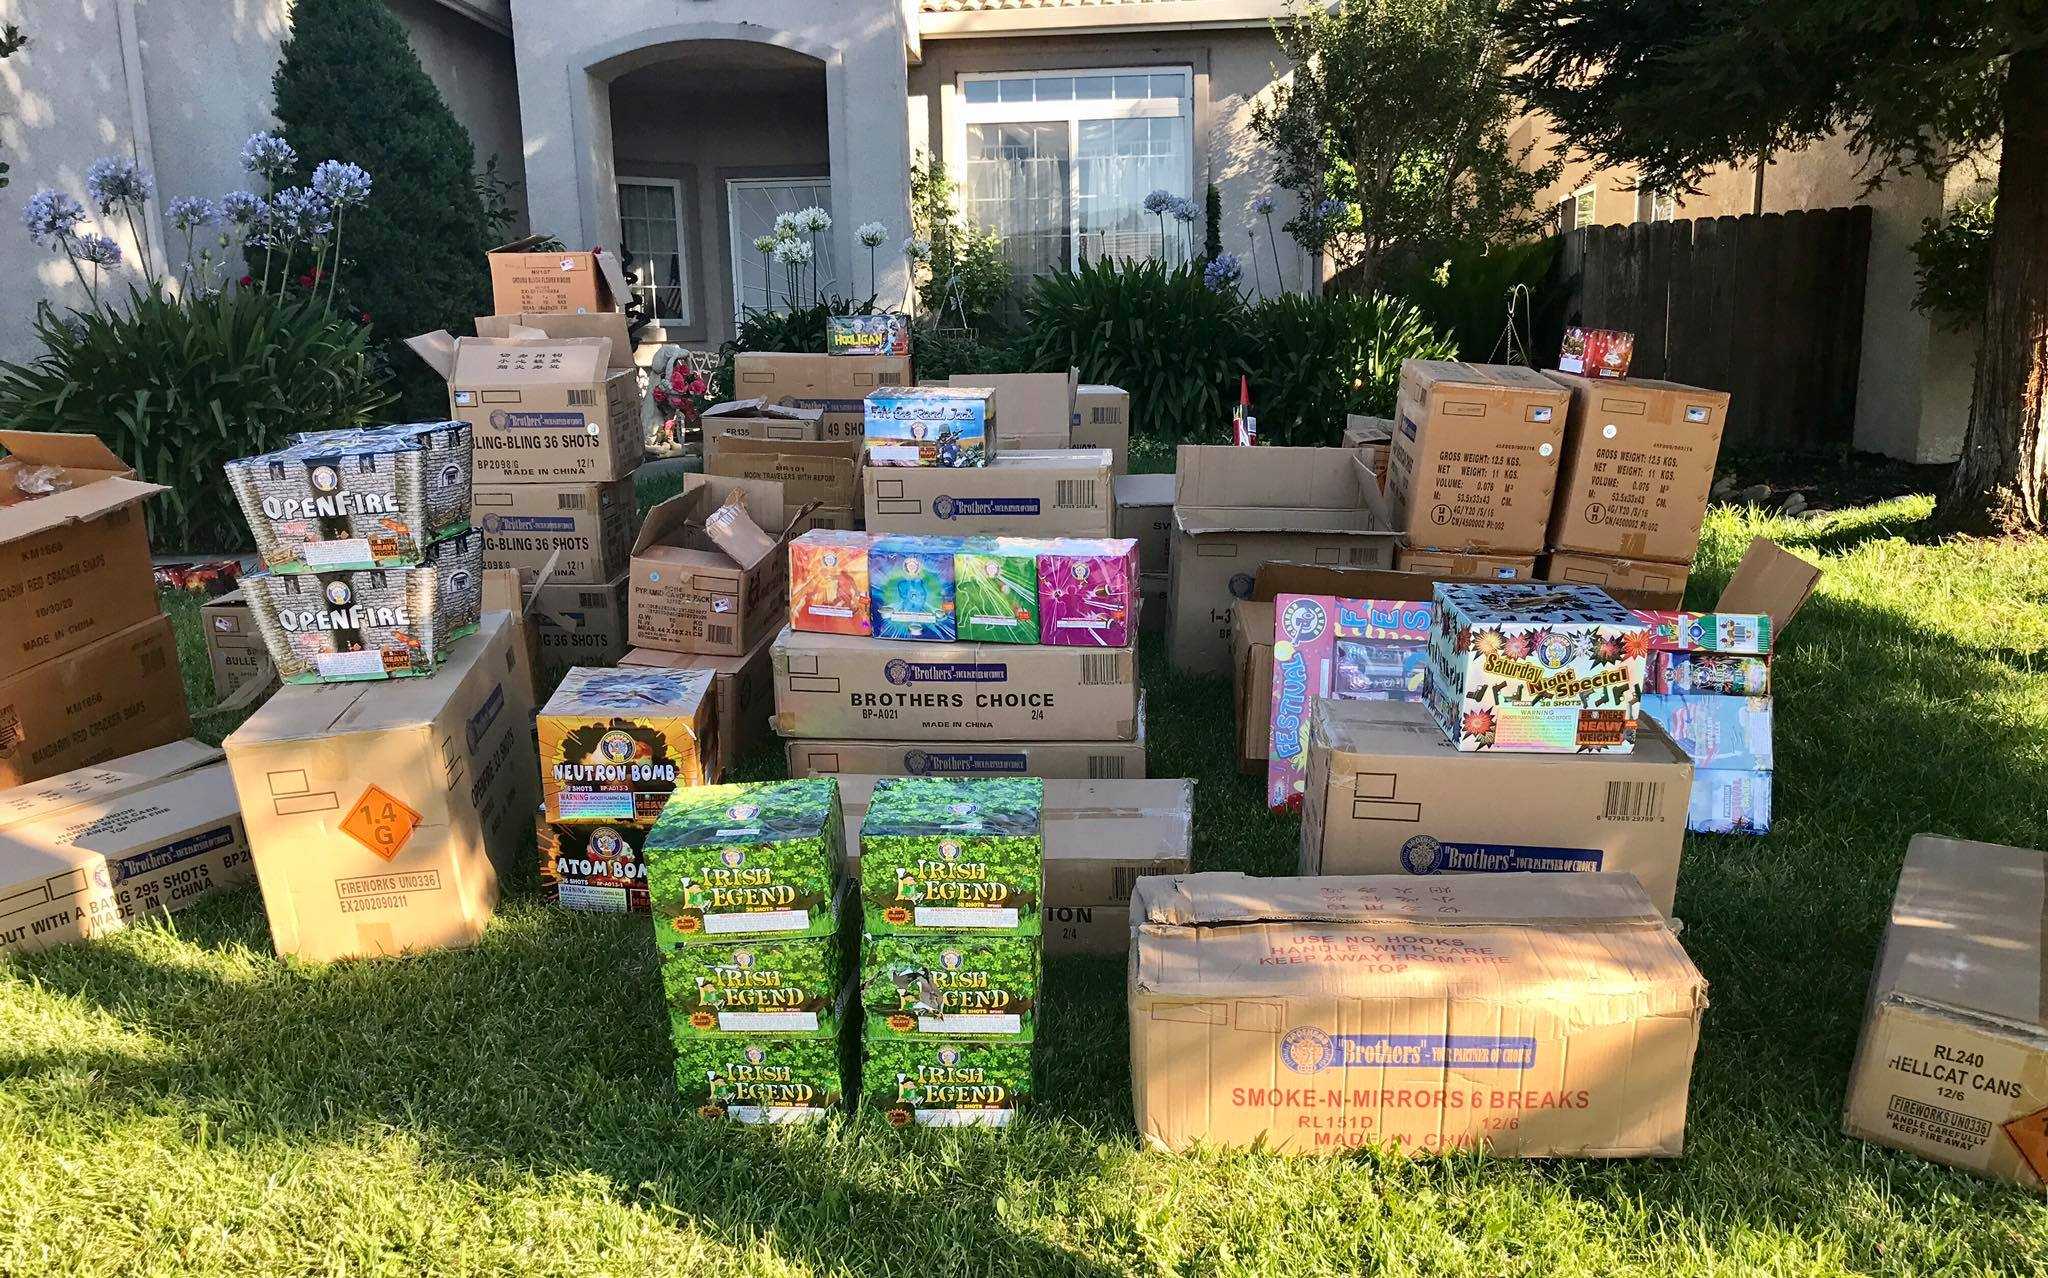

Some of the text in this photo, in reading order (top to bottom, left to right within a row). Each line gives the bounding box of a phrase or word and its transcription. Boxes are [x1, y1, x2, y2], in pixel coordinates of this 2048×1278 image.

[834, 333, 883, 346] HOOLIGAN
[828, 422, 839, 436] 49
[544, 434, 558, 449] 36
[562, 433, 600, 449] SHOTS
[1440, 451, 1461, 462] GROSS
[1596, 448, 1618, 460] GROSS
[503, 468, 534, 476] MADE
[553, 467, 586, 475] CHINA
[1437, 464, 1450, 474] NET
[1461, 466, 1488, 477] WEIGHT:
[1617, 464, 1644, 477] WEIGHT:
[1435, 478, 1464, 489] VOLUME:
[1591, 475, 1620, 488] VOLUME:
[262, 491, 400, 520] OPENFIRE
[535, 537, 589, 551] 36 SHOTS
[277, 605, 411, 632] OPENFIRE
[23, 617, 95, 652] MADE IN CHINA
[554, 634, 608, 647] 36 SHOTS
[1483, 652, 1544, 684] Saturday
[1526, 668, 1576, 695] Night
[1555, 666, 1630, 698] Special
[850, 692, 1055, 708] BROTHERS CHOICE
[1275, 651, 1308, 760] FESTIVAL
[862, 708, 1045, 721] BP-A021 2/4
[1580, 721, 1624, 731] HEAVY
[553, 763, 675, 782] NEUTRON BOMB
[360, 802, 398, 826] 1.4
[374, 825, 394, 846] G
[557, 857, 608, 876] ATOM
[1444, 846, 1515, 871] "Brothers"
[700, 866, 772, 887] IRISH
[917, 859, 990, 881] IRISH
[340, 873, 436, 896] FIREWORKS UN0336
[680, 876, 797, 911] LEGEND
[895, 867, 1008, 905] LEGEND
[31, 911, 70, 936] WITH
[74, 906, 86, 920] A
[89, 889, 131, 915] BANG
[134, 880, 160, 900] 295
[162, 863, 209, 890] SHOTS
[90, 877, 214, 929] MADE IN CHINA
[1062, 927, 1077, 940] 2/4
[1293, 935, 1466, 947] USE NO HOOKS
[1259, 953, 1316, 966] KEEP
[1323, 954, 1384, 963] AWAY
[1391, 954, 1458, 963] FROM
[1271, 944, 1495, 955] HANDLE WITH CARE
[713, 967, 783, 988] IRISH
[1367, 964, 1408, 974] TOP
[695, 976, 805, 1011] LEGEND
[1933, 1044, 1985, 1068] RL240
[725, 1062, 792, 1082] IRISH
[917, 1064, 985, 1085] IRISH
[1888, 1055, 2023, 1099] HELLCAT CANS
[706, 1070, 813, 1104] LEGEND
[895, 1072, 1006, 1106] LEGEND
[1937, 1086, 1966, 1101] 12/6
[1232, 1087, 1591, 1109] SMOKE-N-MIRRORS 6 BREAKS
[1298, 1115, 1520, 1130] RL151D 12/6
[1894, 1098, 1988, 1135] FIREWORKS UN0336
[1886, 1111, 1987, 1146] HANDLE CAREFULLY
[1891, 1122, 1975, 1151] KEEP FIRE AWAY
[1313, 1132, 1379, 1147] MADE
